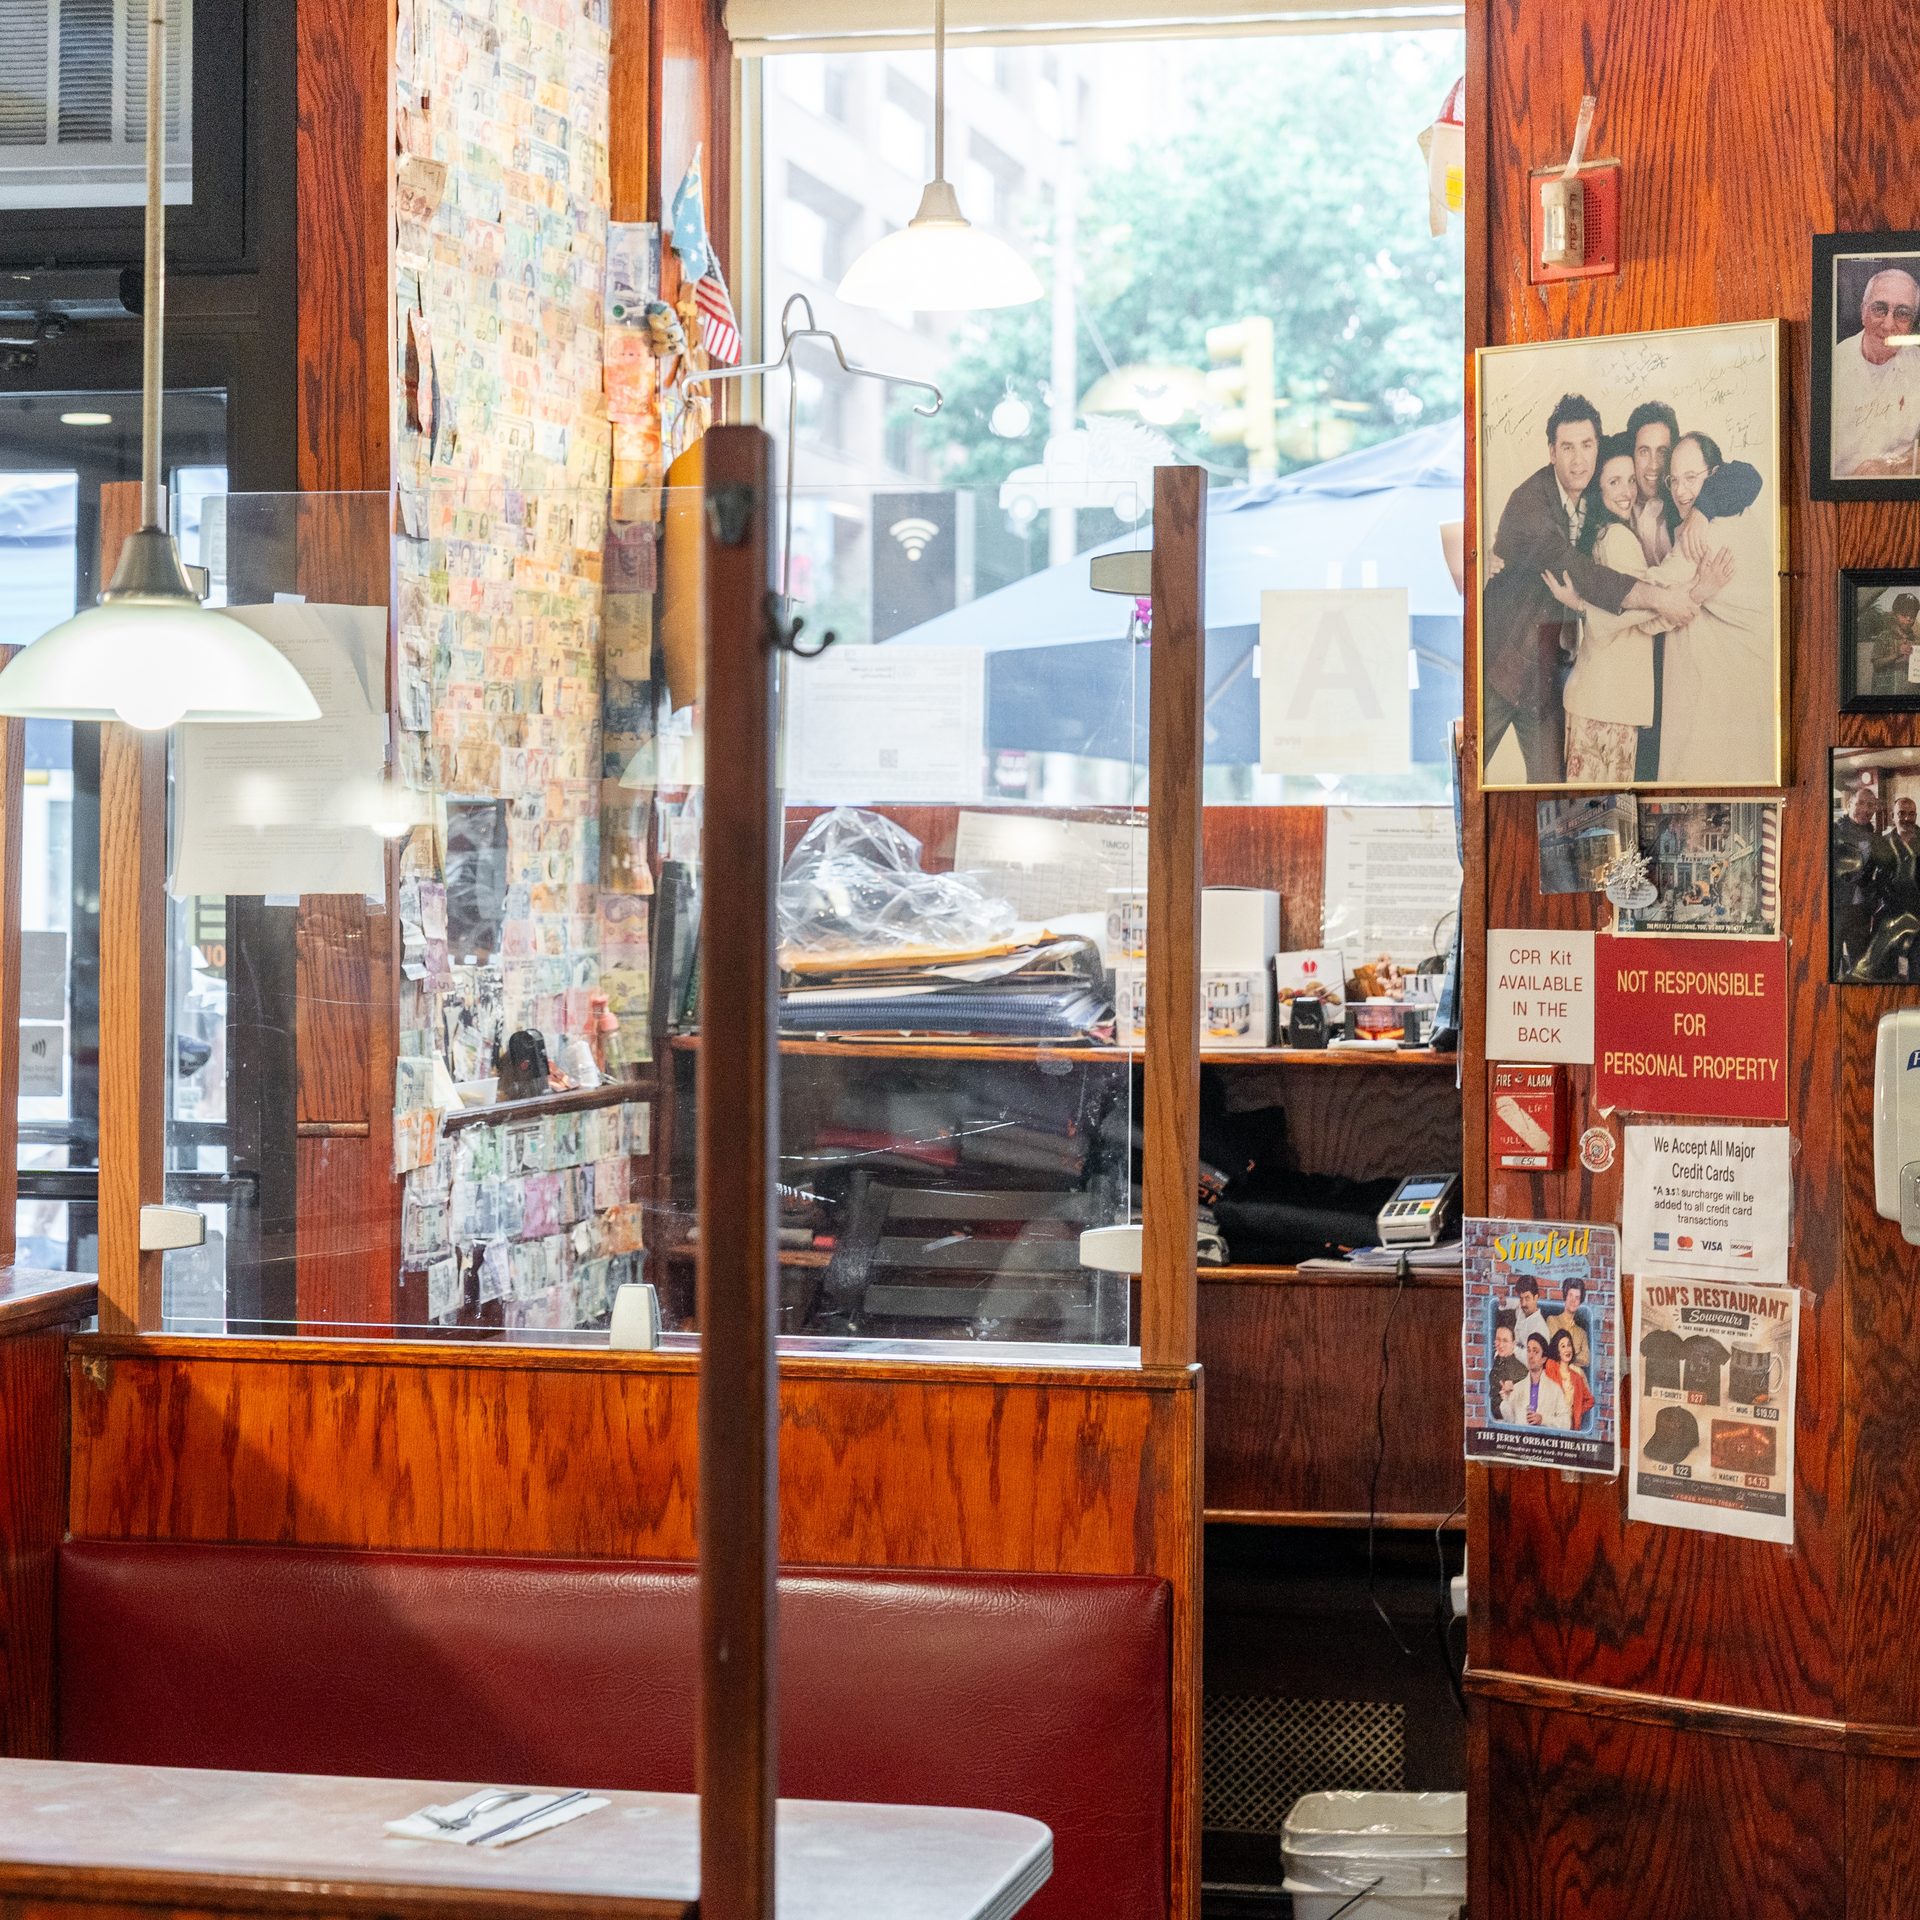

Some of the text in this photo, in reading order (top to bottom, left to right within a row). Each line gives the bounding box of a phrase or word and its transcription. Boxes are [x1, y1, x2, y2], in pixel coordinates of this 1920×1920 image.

[1509, 949, 1572, 966] CPR Kit
[1498, 975, 1583, 992] AVAILABLE
[1617, 970, 1765, 997] NOT RESPONSIBLE
[1512, 1001, 1568, 1018] IN THE
[1674, 1013, 1706, 1037] FOR
[1518, 1027, 1562, 1043] BACK
[1604, 1051, 1779, 1082] PERSONAL PROPERTY
[1496, 1074, 1552, 1087] FIRE ALARM
[1653, 1136, 1756, 1162] We Accept All Major
[1672, 1162, 1735, 1182] Credit Cards
[1681, 1188, 1724, 1202] surcharge
[1725, 1191, 1740, 1201] will
[1743, 1192, 1754, 1203] be
[1654, 1199, 1753, 1216] added to all credit card
[1677, 1213, 1729, 1227] transactions
[1493, 1227, 1590, 1264] Singfeld
[1701, 1240, 1723, 1252] VISA
[1646, 1286, 1789, 1321] TOM'S RESTAURANT
[1688, 1310, 1743, 1326] Souvenirs
[1689, 1393, 1703, 1403] $27
[1736, 1406, 1777, 1419] MUG $19.50
[1476, 1431, 1599, 1453] THE JERRY ORBACH THEATER
[1658, 1464, 1689, 1476] CAP $22
[1718, 1474, 1767, 1488] MAGNET $4.75
